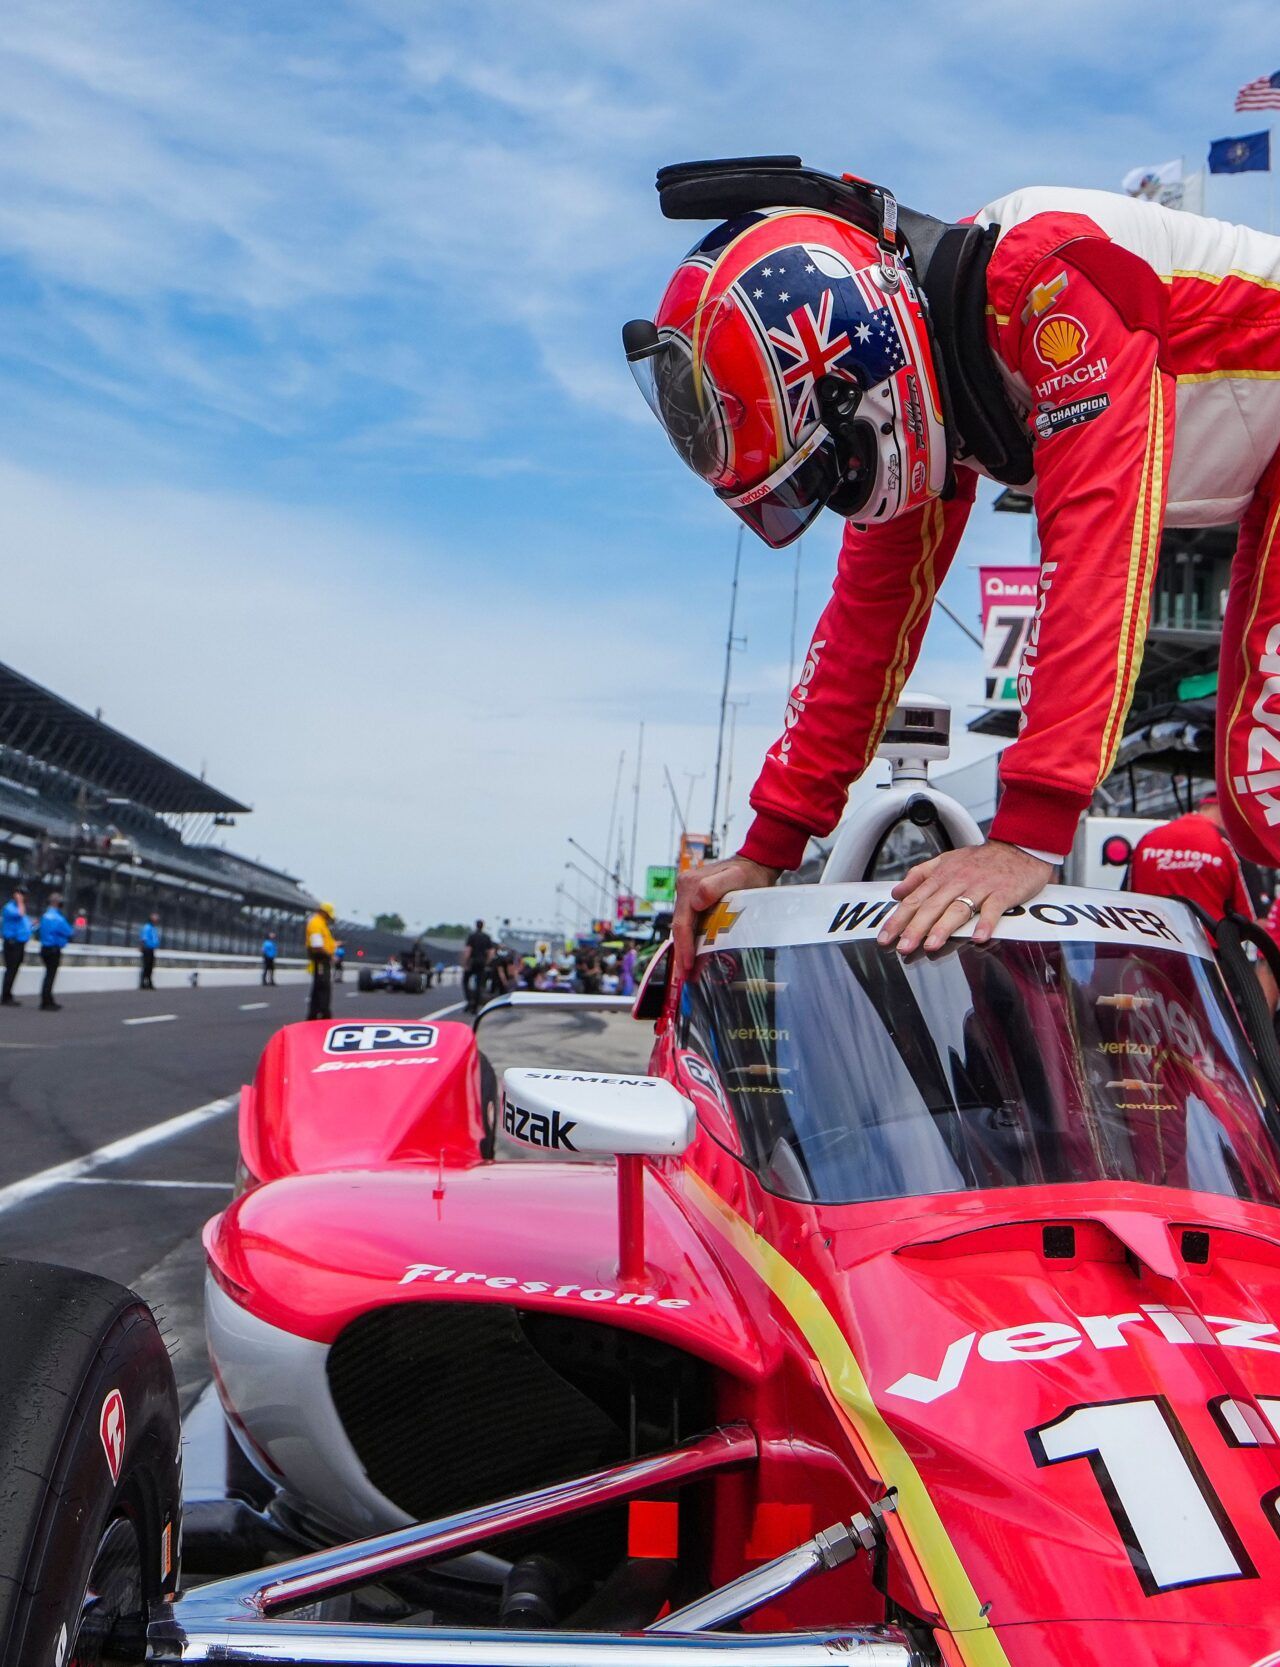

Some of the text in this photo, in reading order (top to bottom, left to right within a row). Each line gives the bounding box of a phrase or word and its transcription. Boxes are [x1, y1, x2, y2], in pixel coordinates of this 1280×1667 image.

[1036, 357, 1108, 398] HITACHI
[1051, 396, 1107, 423] CHAMPION
[738, 484, 771, 505] verizon
[331, 1026, 432, 1050] PPG
[728, 1024, 790, 1041] verizon
[1097, 1036, 1158, 1057] verizon
[311, 1057, 440, 1073] Snap-on
[524, 1073, 657, 1087] SIEMENS
[728, 1085, 794, 1096] verizon
[1114, 1102, 1178, 1111] verizon
[397, 1263, 692, 1309] Firestone
